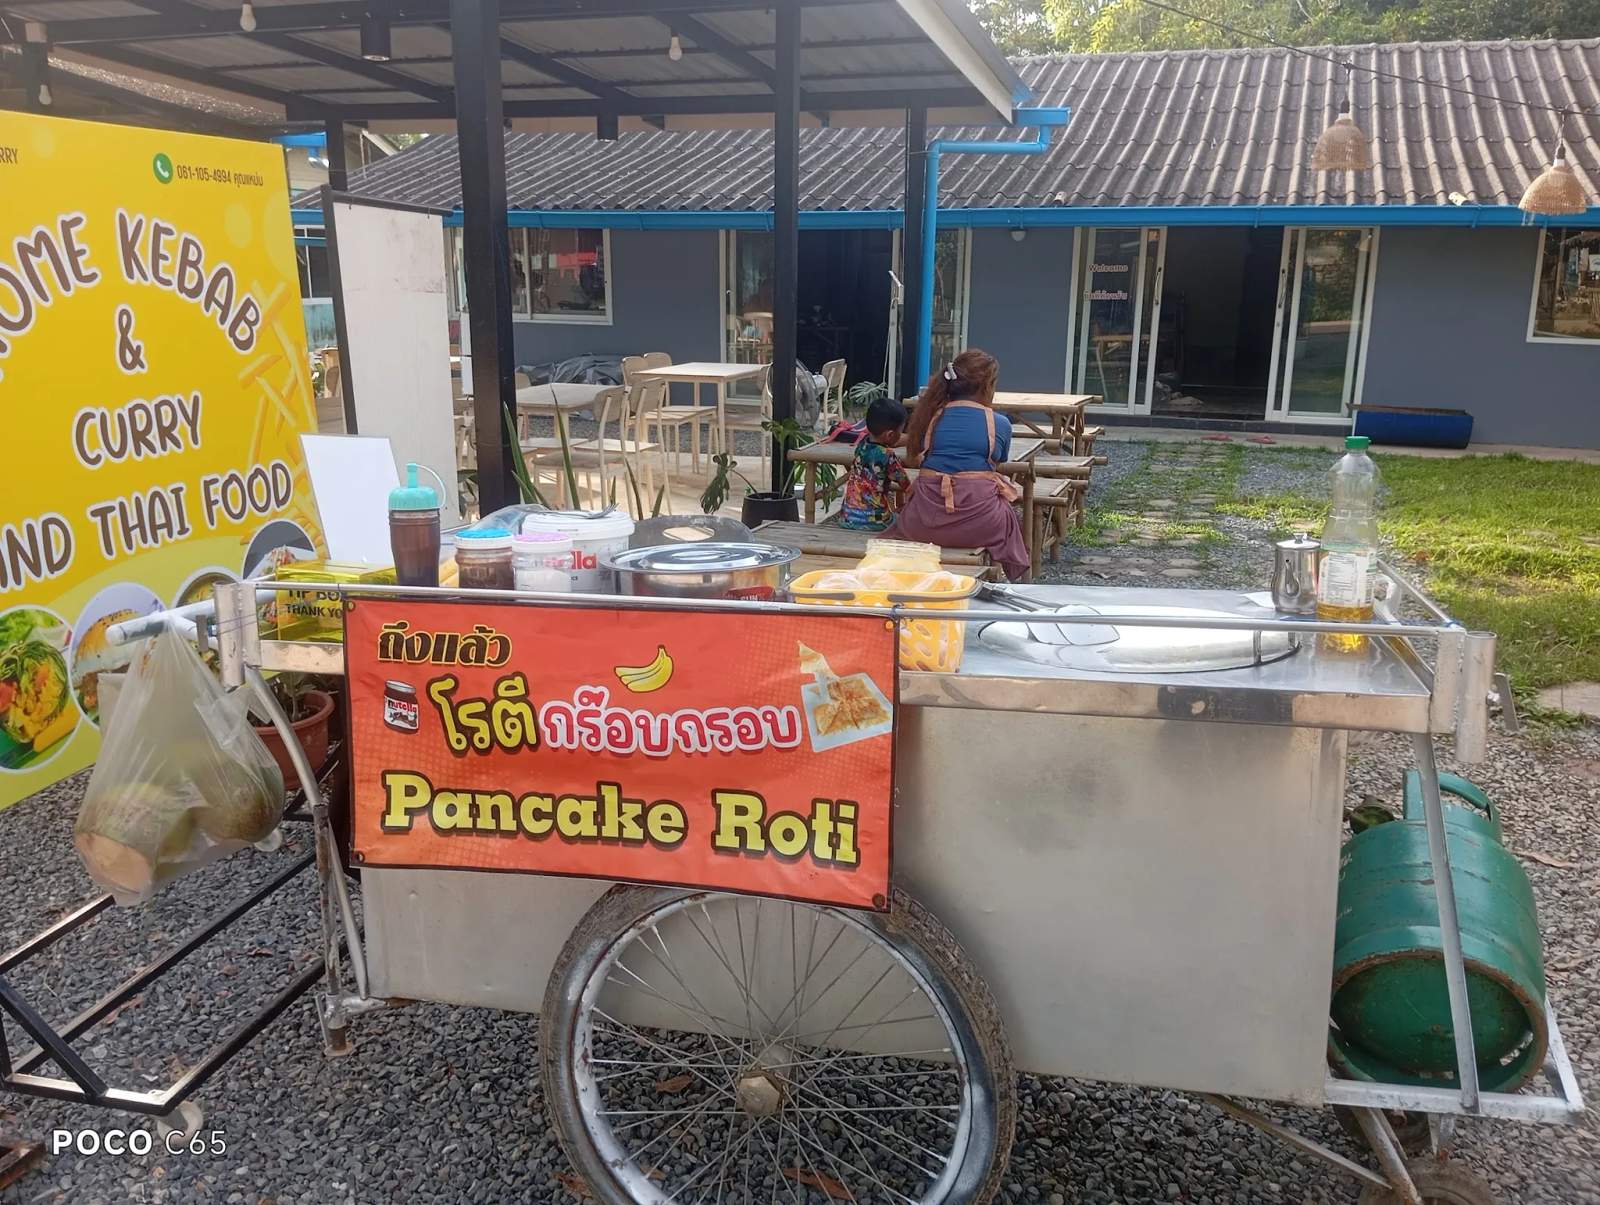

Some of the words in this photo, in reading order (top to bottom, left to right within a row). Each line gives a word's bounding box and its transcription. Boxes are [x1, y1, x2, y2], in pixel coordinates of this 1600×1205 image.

[0, 215, 99, 352] OME
[117, 210, 261, 352] KEBAB
[117, 307, 146, 371] &
[74, 394, 201, 467] CURRY
[89, 485, 191, 557] THAI
[202, 461, 293, 527] FOOD
[286, 603, 325, 618] THANK
[327, 607, 343, 619] YO
[382, 772, 686, 846] Pancake
[712, 791, 860, 866] Roti
